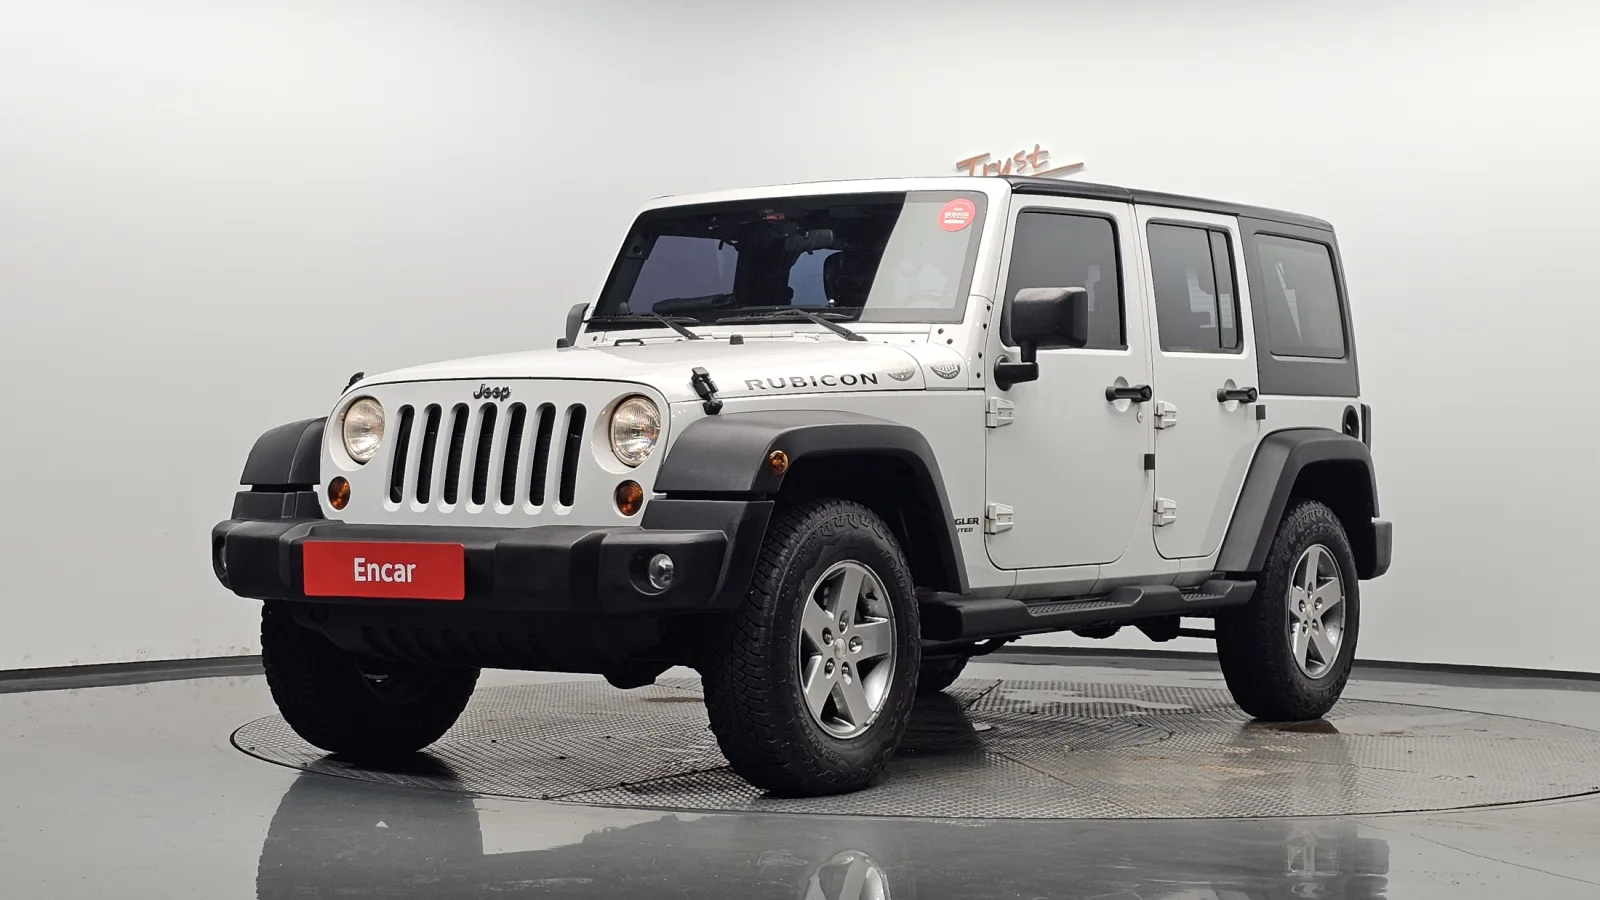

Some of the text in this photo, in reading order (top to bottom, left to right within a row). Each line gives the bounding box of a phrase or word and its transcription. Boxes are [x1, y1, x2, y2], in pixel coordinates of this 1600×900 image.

[956, 143, 1049, 176] Trust
[473, 383, 511, 402] Jeep
[745, 373, 878, 391] RUBICON
[353, 557, 417, 583] Encar
